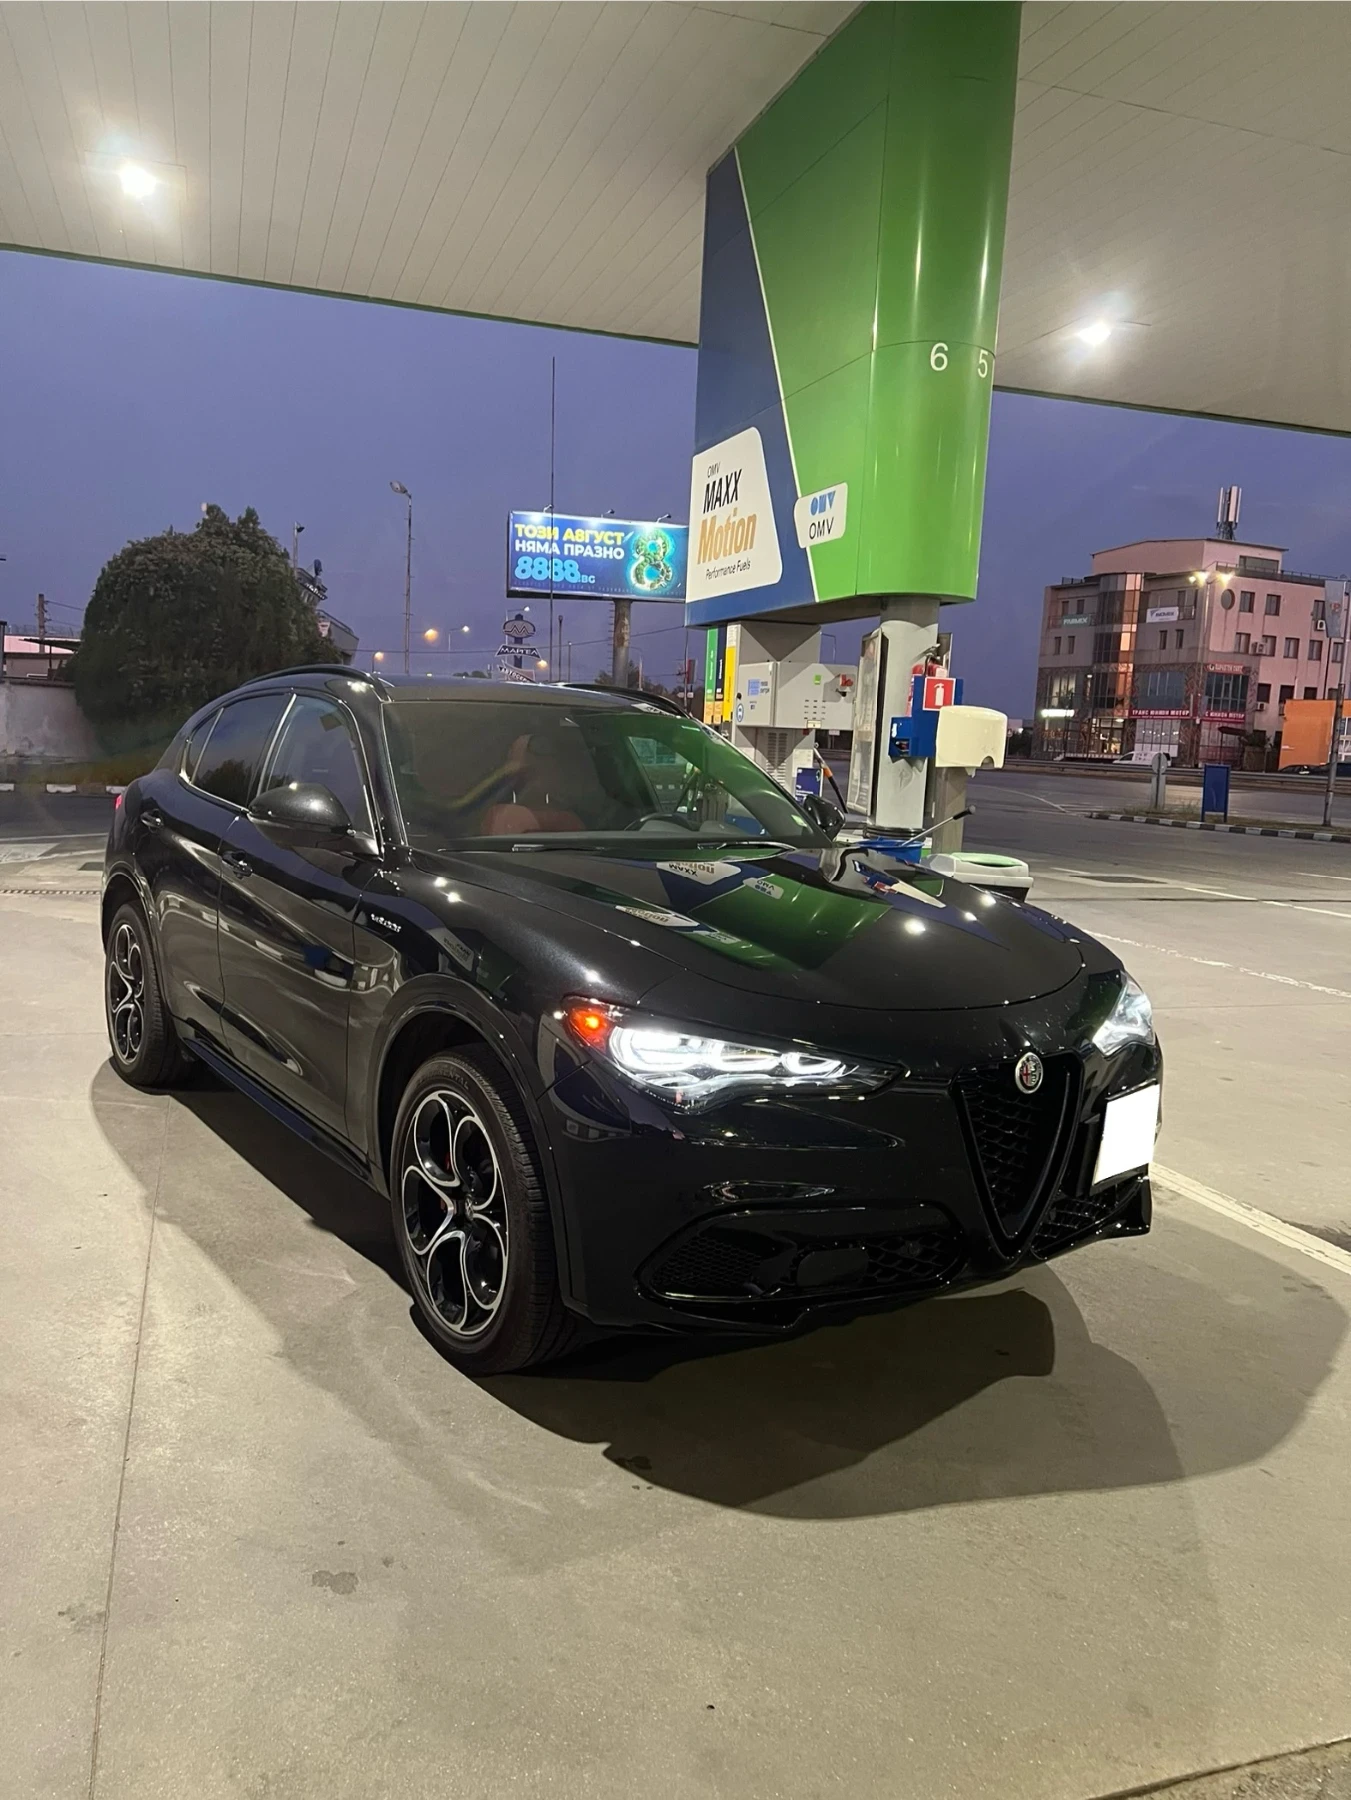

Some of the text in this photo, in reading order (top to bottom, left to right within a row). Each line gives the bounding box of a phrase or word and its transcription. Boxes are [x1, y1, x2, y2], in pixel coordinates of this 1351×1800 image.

[930, 342, 949, 372] 6
[977, 349, 989, 378] 5
[706, 462, 721, 479] OMV
[702, 468, 743, 515] MAXX
[514, 523, 560, 541] ТОЗИ
[697, 507, 758, 565] Motion
[808, 517, 835, 540] OMV
[514, 539, 625, 560] НЯМА ПРАЗНО
[514, 555, 596, 584] 8888.BG
[705, 557, 751, 581] Performance Fuels
